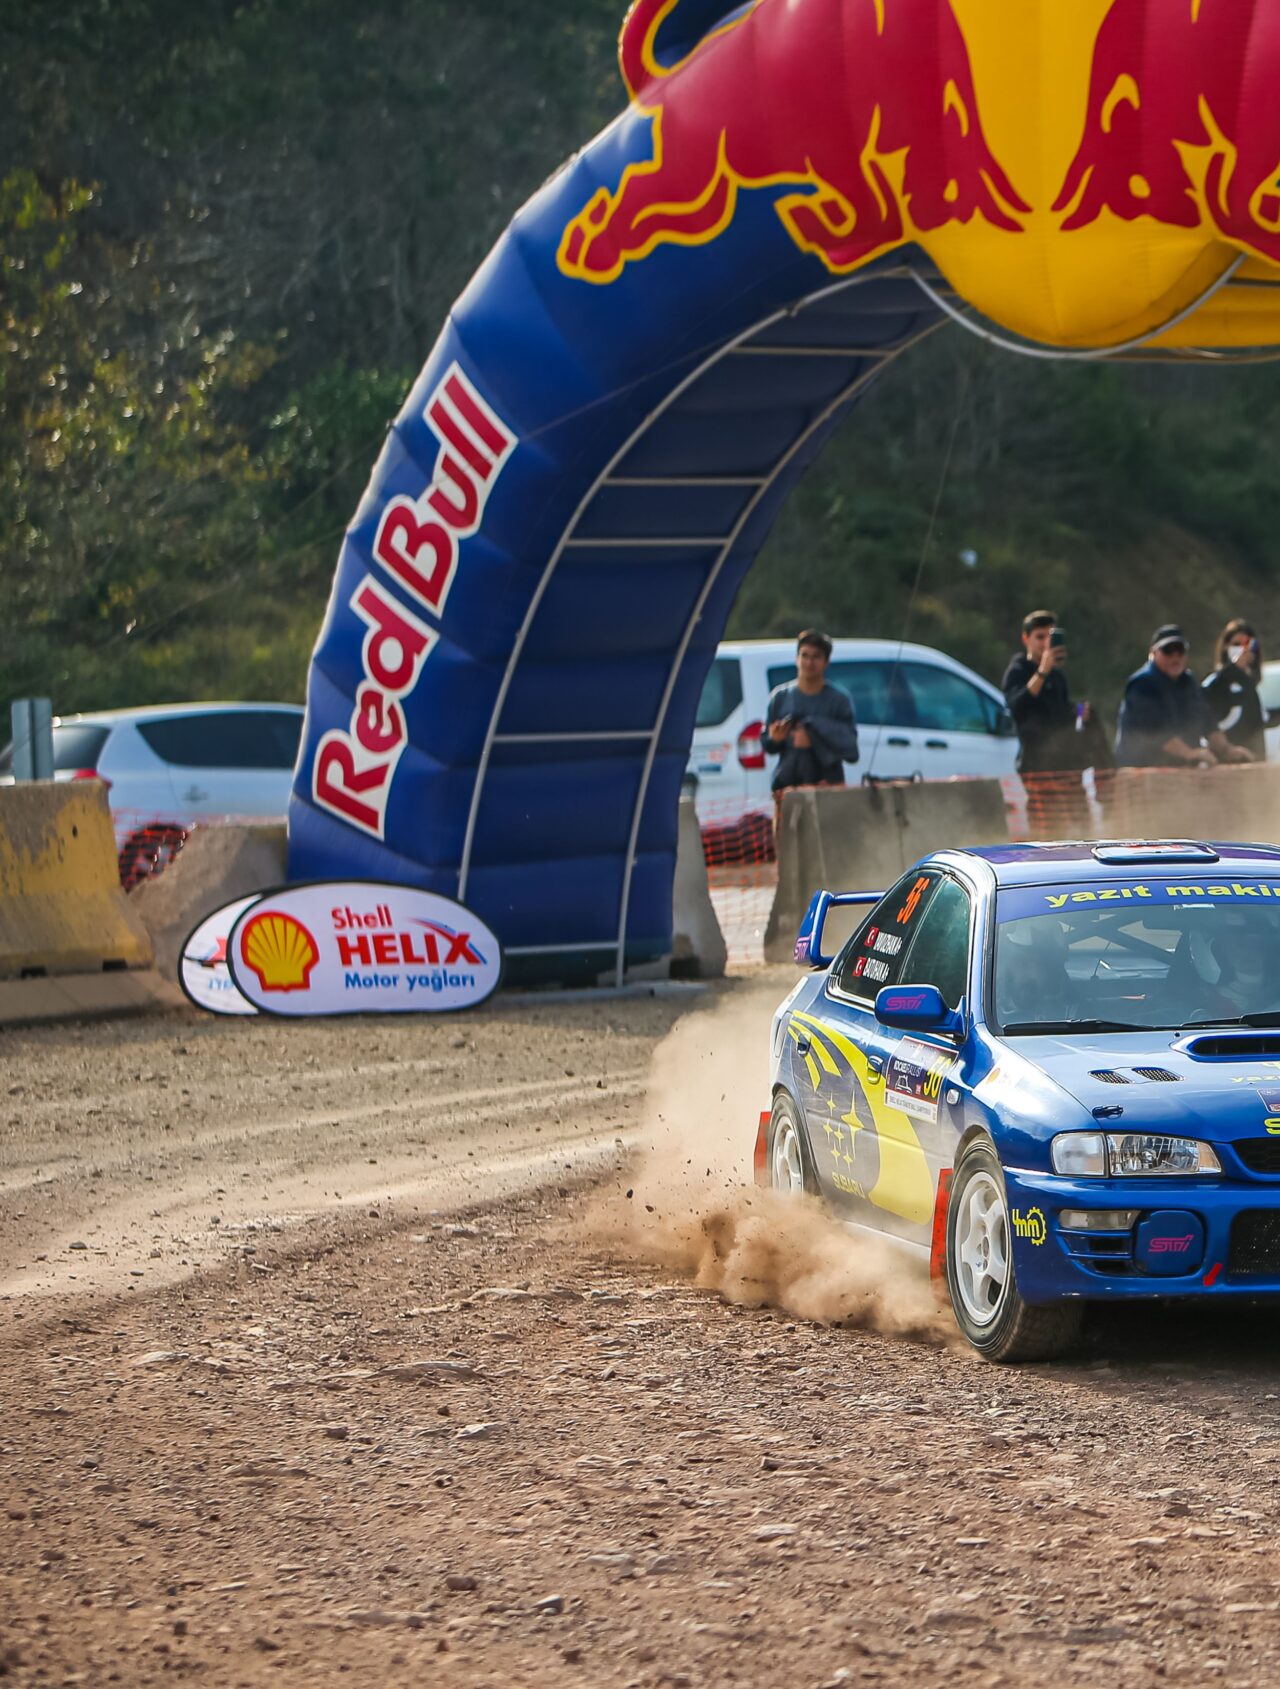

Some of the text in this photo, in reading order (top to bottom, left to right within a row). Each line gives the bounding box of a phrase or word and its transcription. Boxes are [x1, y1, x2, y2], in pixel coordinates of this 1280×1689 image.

[313, 360, 518, 841] Red Bull
[331, 904, 392, 929] Shell
[896, 877, 929, 924] 56
[336, 932, 485, 966] HELIX
[345, 969, 475, 992] Motor yağları
